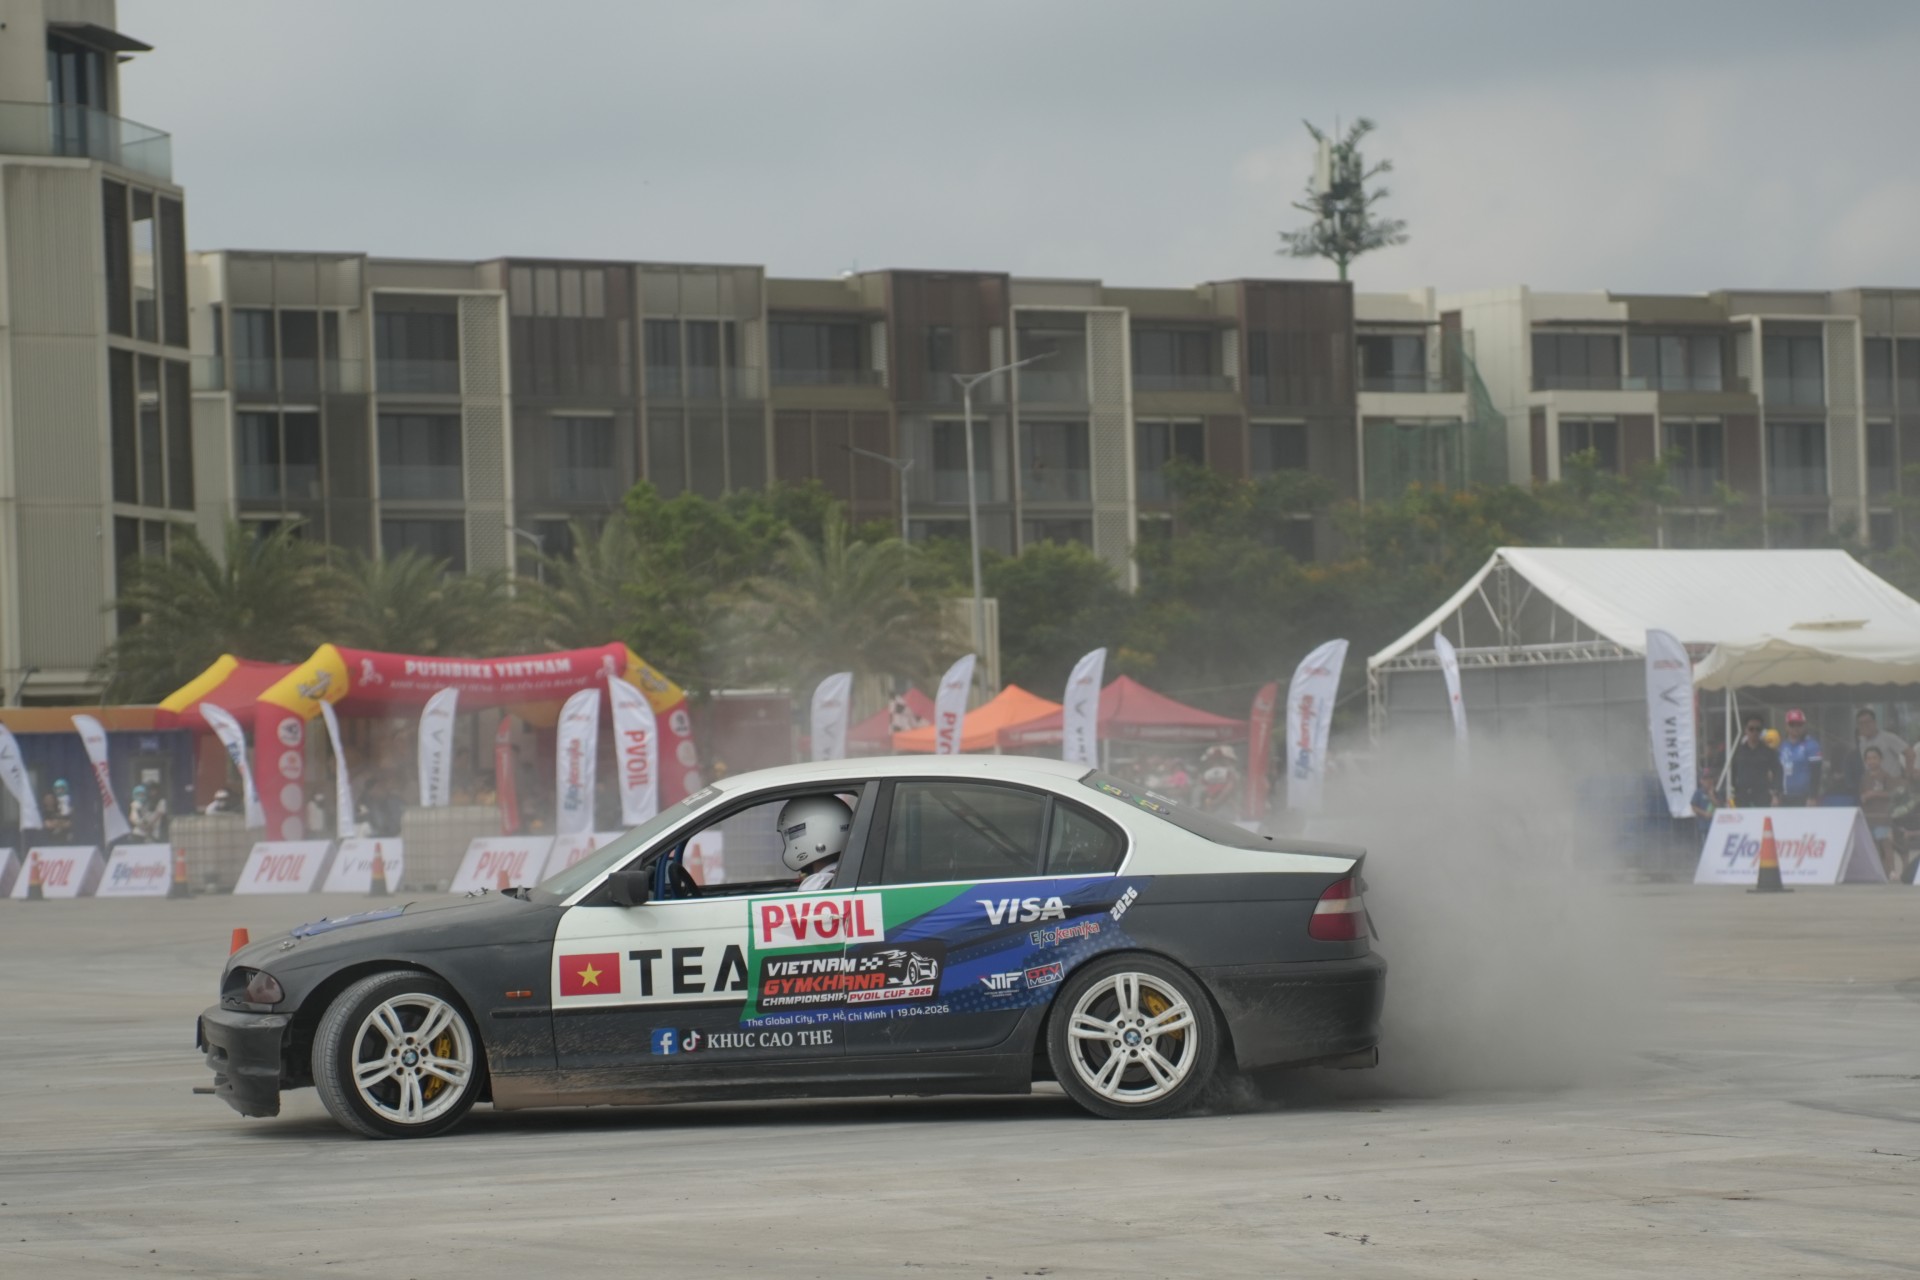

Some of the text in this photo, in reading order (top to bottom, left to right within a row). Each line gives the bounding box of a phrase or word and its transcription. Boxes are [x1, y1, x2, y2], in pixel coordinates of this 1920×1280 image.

[494, 658, 571, 677] VIETNAM
[623, 729, 649, 791] PVOIL
[1664, 715, 1684, 794] VINFAST
[253, 853, 306, 883] PVOIL
[976, 896, 1071, 926] VISA
[1109, 885, 1139, 921] 2026
[761, 899, 875, 943] PVOIL
[1030, 920, 1101, 949] Ekokemika
[767, 957, 856, 977] VIETNAM
[763, 972, 887, 996] GYMKHANA
[849, 987, 931, 1001] PVOIL CUP 2026
[746, 1018, 764, 1027] The
[765, 1016, 793, 1026] Global
[795, 1015, 815, 1025] City,
[816, 1013, 832, 1022] TP.
[848, 1012, 862, 1021] Chí
[864, 1011, 887, 1020] Minh
[897, 1004, 950, 1017] 19.04.2026
[707, 1029, 833, 1049] KHUC CAO THE
